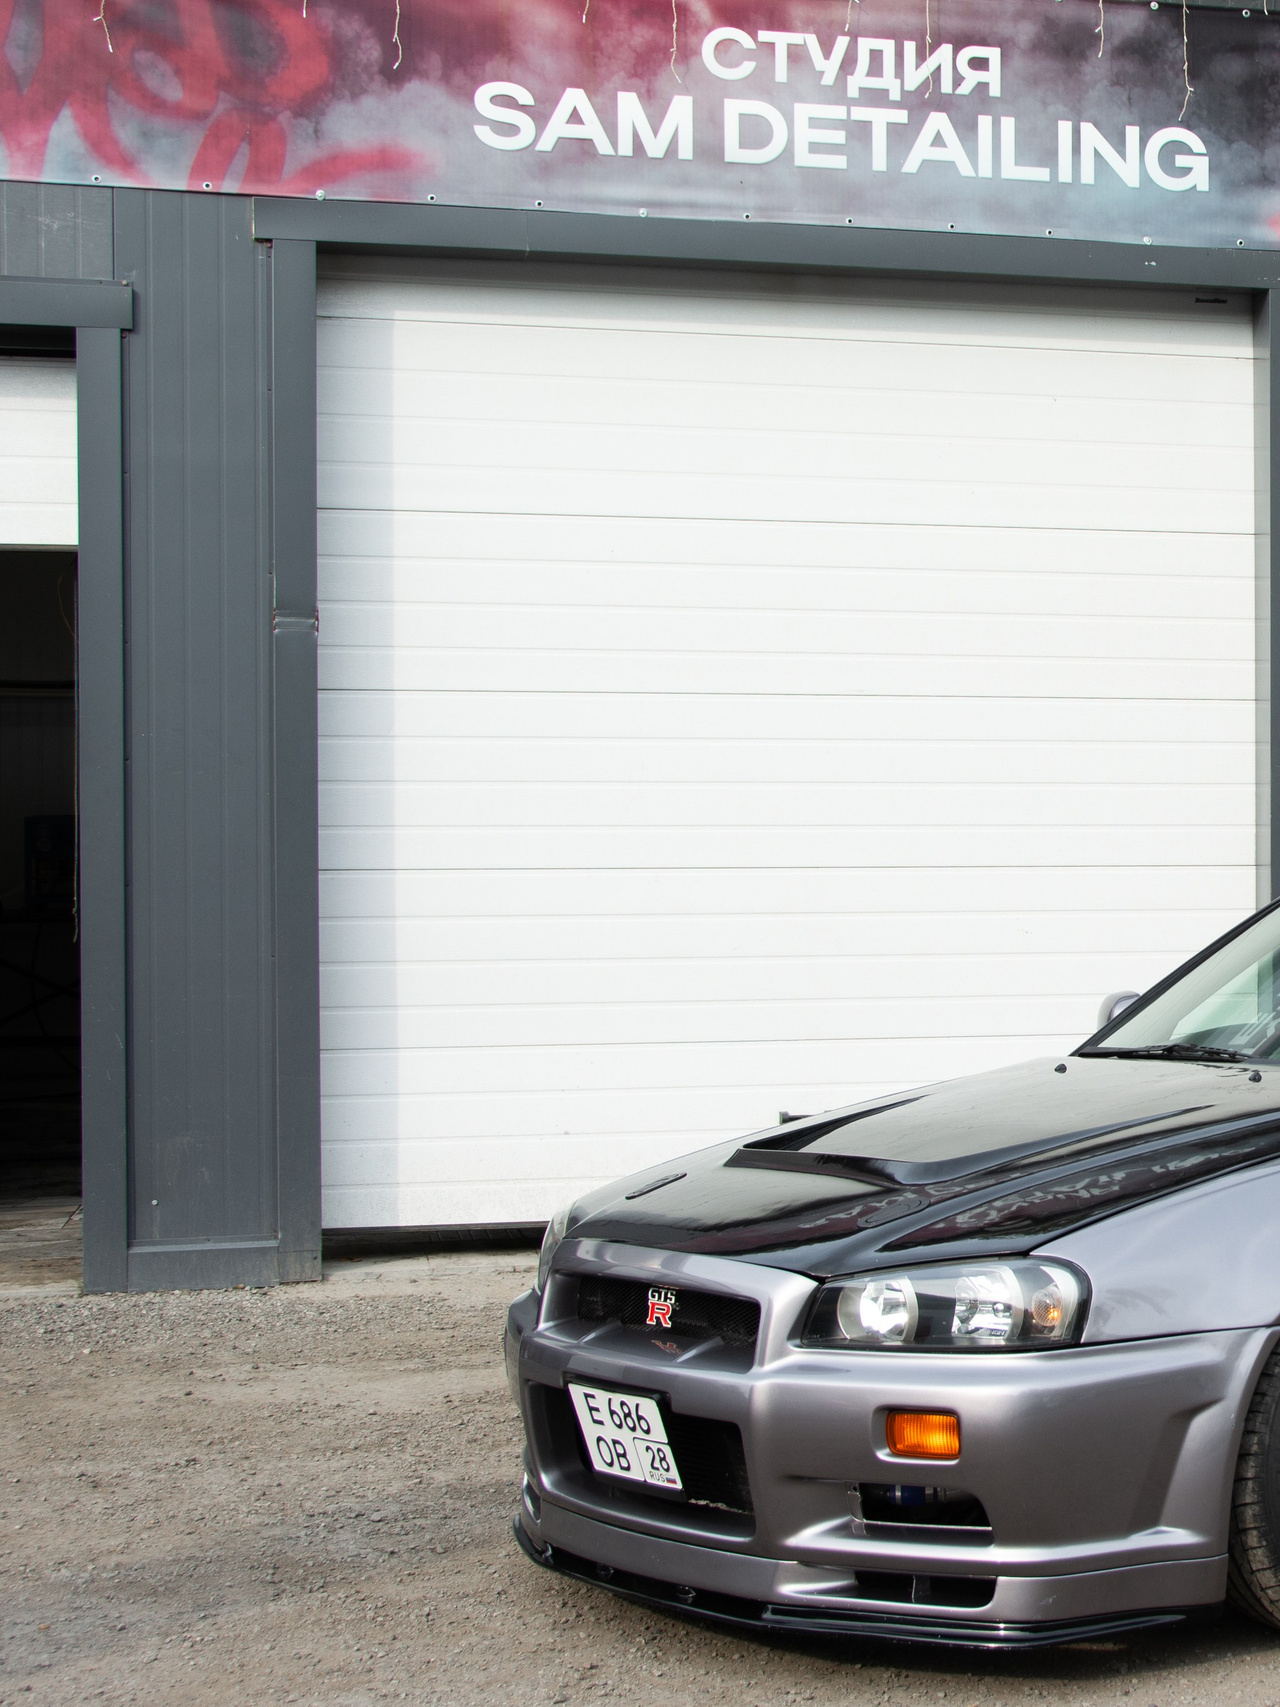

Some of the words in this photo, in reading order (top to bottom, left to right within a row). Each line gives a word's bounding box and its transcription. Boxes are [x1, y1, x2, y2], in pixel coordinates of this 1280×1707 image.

[701, 27, 1001, 100] СТУДИЯ
[473, 81, 693, 160] SAM
[724, 98, 1209, 192] DETAILING
[648, 1287, 676, 1303] GTS
[647, 1301, 672, 1327] R
[608, 1397, 651, 1435] 686
[646, 1445, 670, 1473] 28
[649, 1470, 666, 1483] RUS
